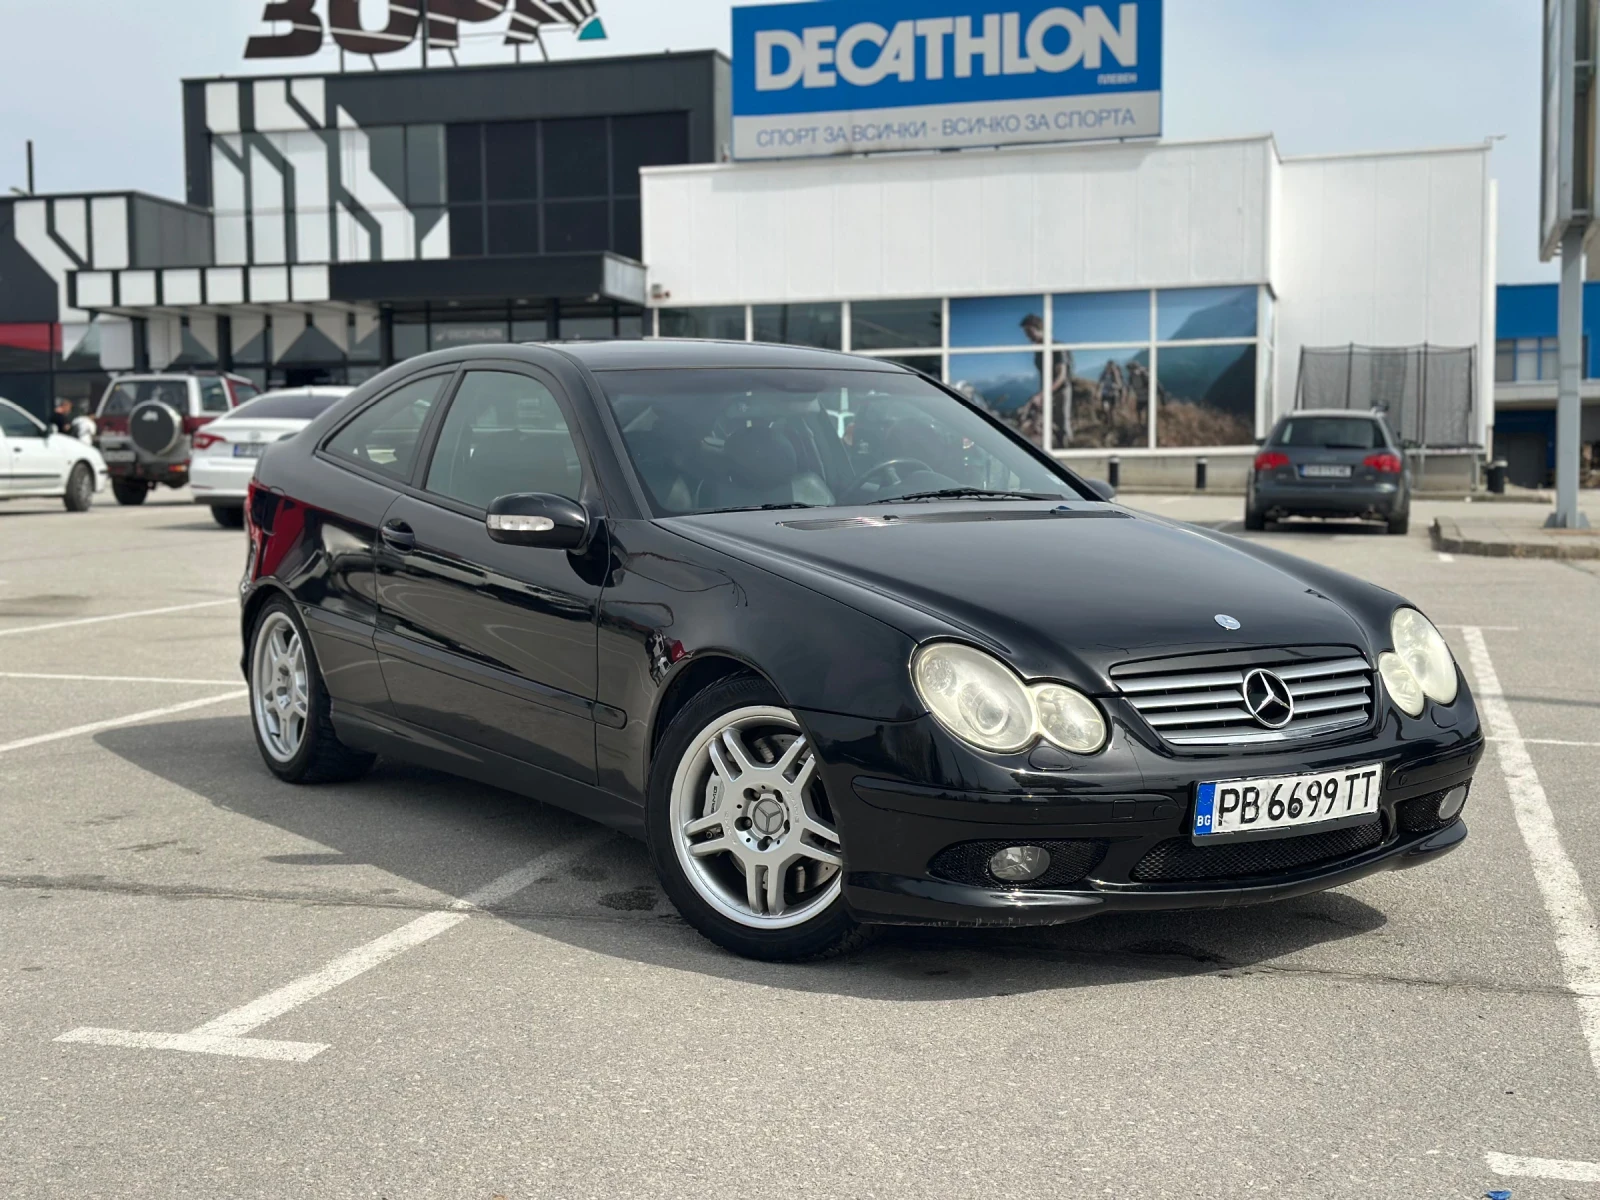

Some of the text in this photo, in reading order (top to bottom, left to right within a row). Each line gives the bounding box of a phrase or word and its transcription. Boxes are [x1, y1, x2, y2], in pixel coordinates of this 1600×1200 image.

[755, 3, 1138, 91] DECATHLON
[756, 127, 819, 148] СПОРТ
[823, 125, 848, 144] ЗА
[852, 120, 928, 143] ВСИЧКИ
[942, 114, 1021, 137] ВСИЧКО
[1025, 112, 1050, 131] ЗА
[1054, 107, 1135, 129] СПОРТА
[1267, 778, 1339, 821] 6699
[1344, 770, 1377, 811] TT
[1197, 815, 1212, 827] BG
